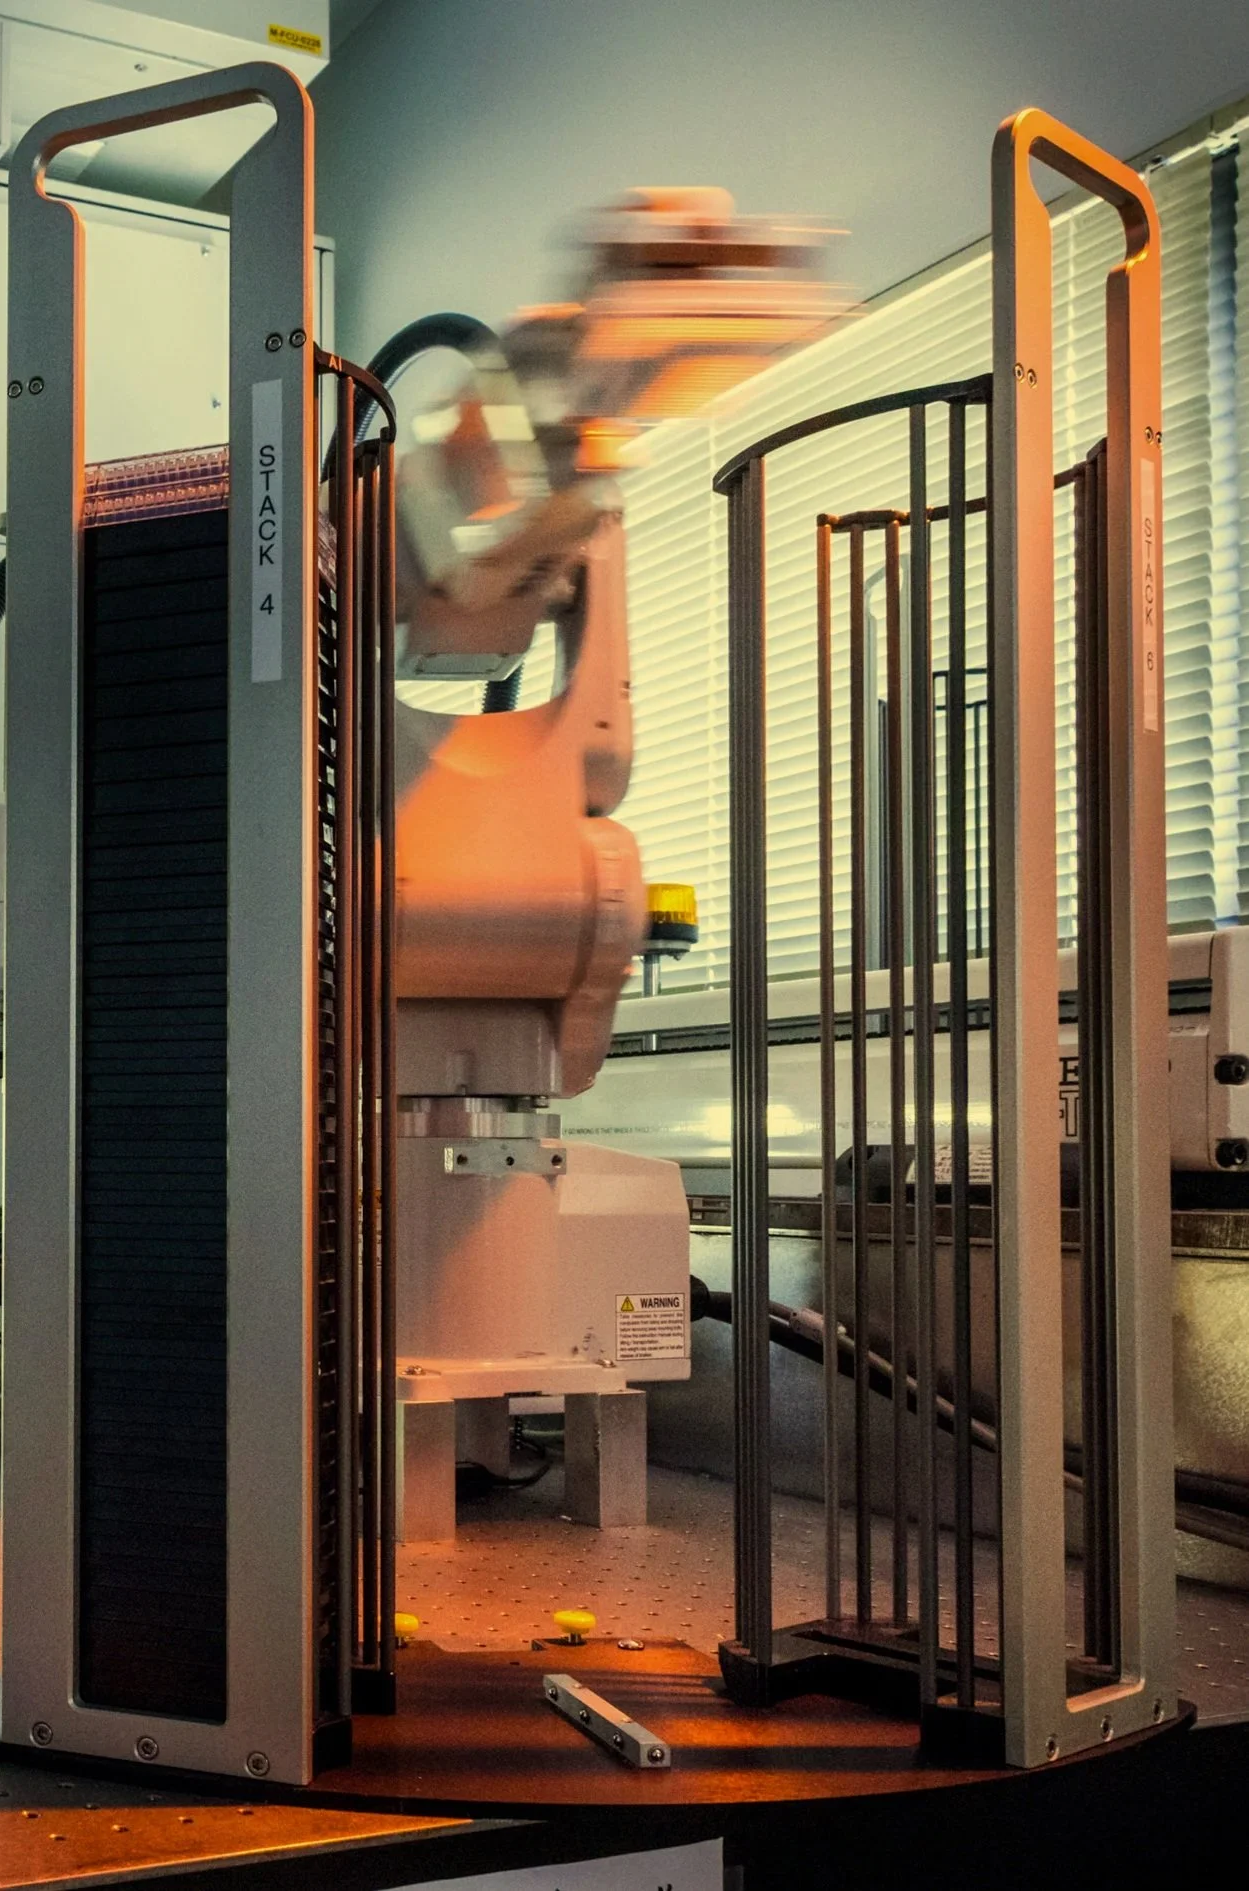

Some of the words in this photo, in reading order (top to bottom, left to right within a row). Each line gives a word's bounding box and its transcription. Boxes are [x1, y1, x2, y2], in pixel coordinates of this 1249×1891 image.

[258, 445, 276, 566] STACK
[1144, 517, 1154, 626] STACK
[259, 593, 275, 615] 4
[1147, 651, 1154, 671] 6
[640, 1297, 680, 1308] WARNING
